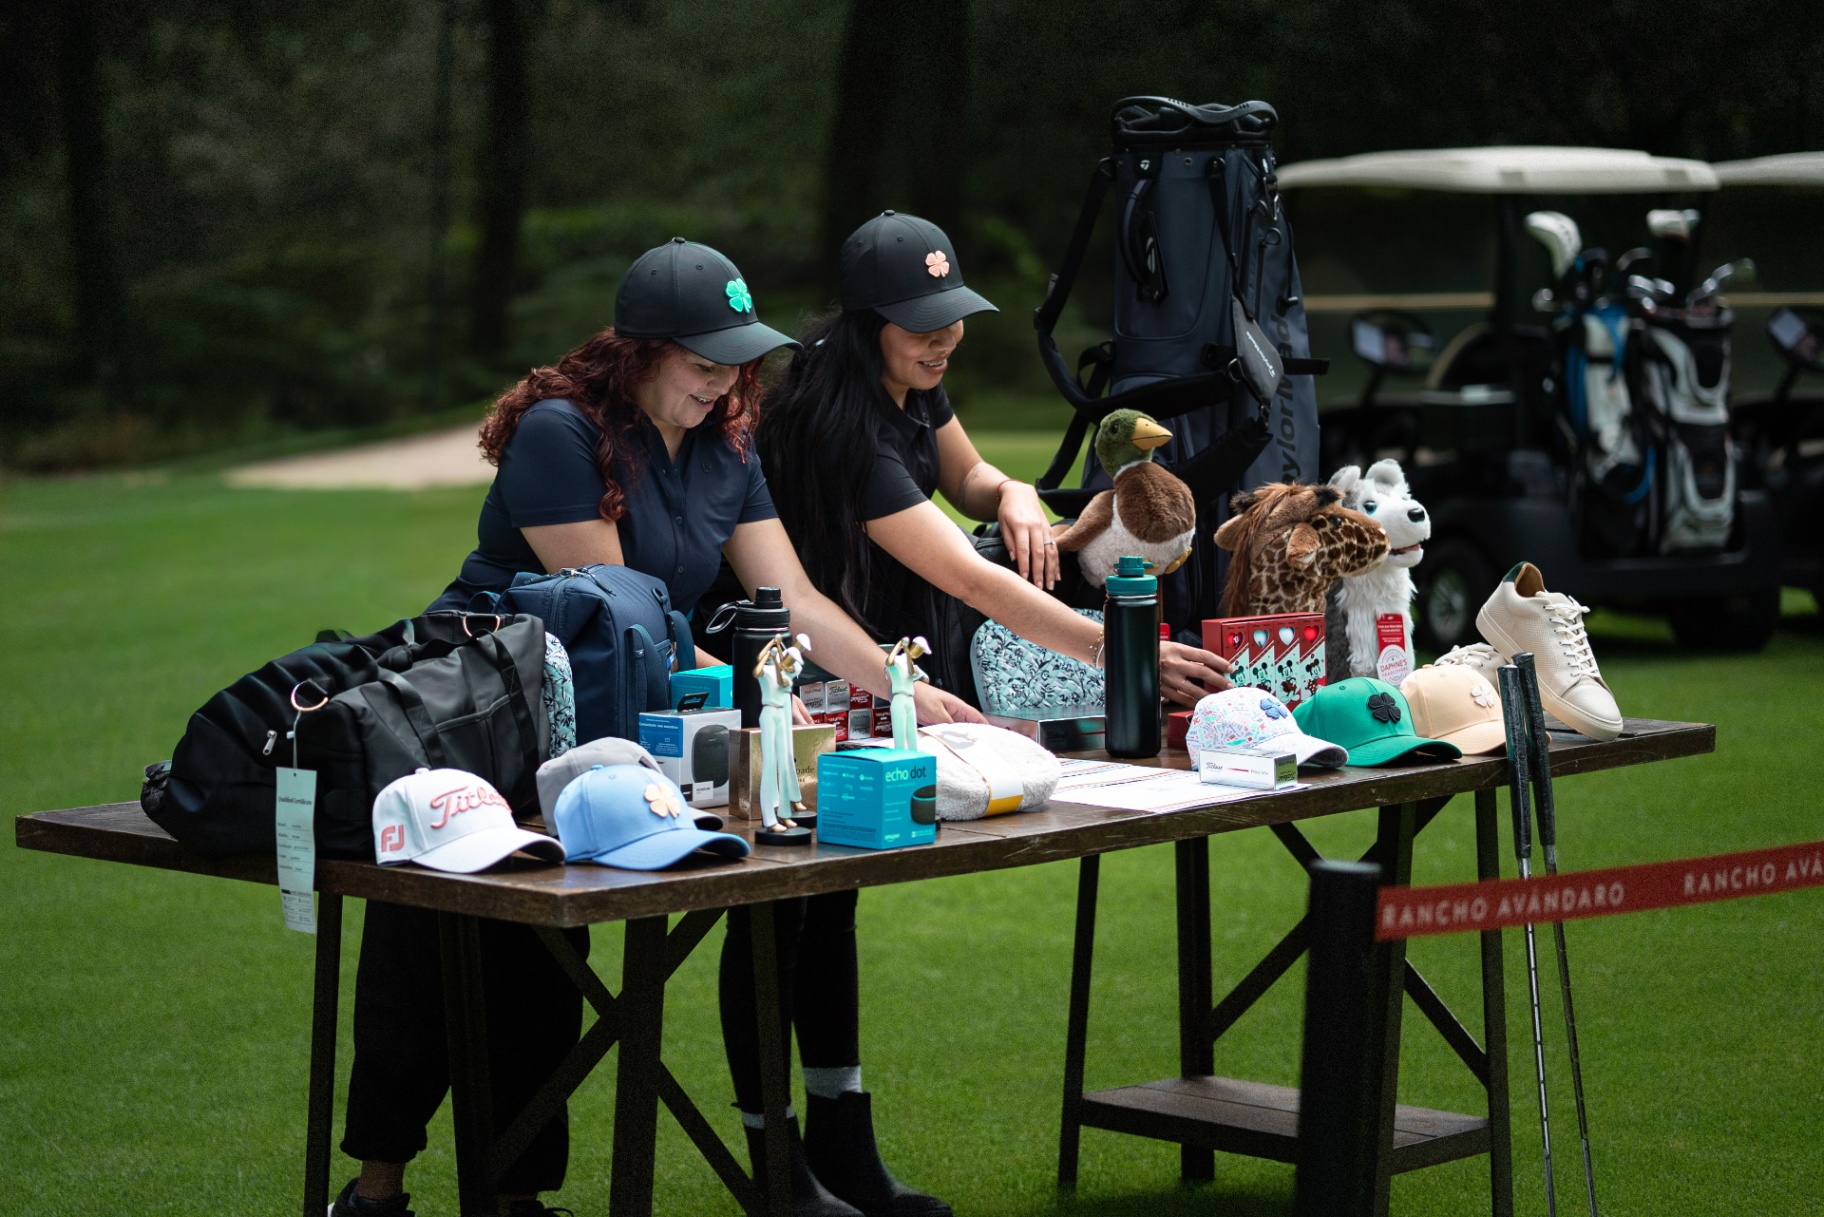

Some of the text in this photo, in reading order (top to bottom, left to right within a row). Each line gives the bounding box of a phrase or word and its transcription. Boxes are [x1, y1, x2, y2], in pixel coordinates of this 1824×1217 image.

[1270, 296, 1301, 484] aylorMade
[1380, 658, 1408, 673] DAPHNE'S
[795, 765, 815, 774] pade
[885, 767, 908, 782] echo
[910, 765, 927, 779] dot
[430, 786, 512, 829] Titlei
[381, 824, 405, 852] FJ
[1684, 862, 1776, 896] RANCHO
[1381, 881, 1625, 928] RANCHO AVÁNDARO
